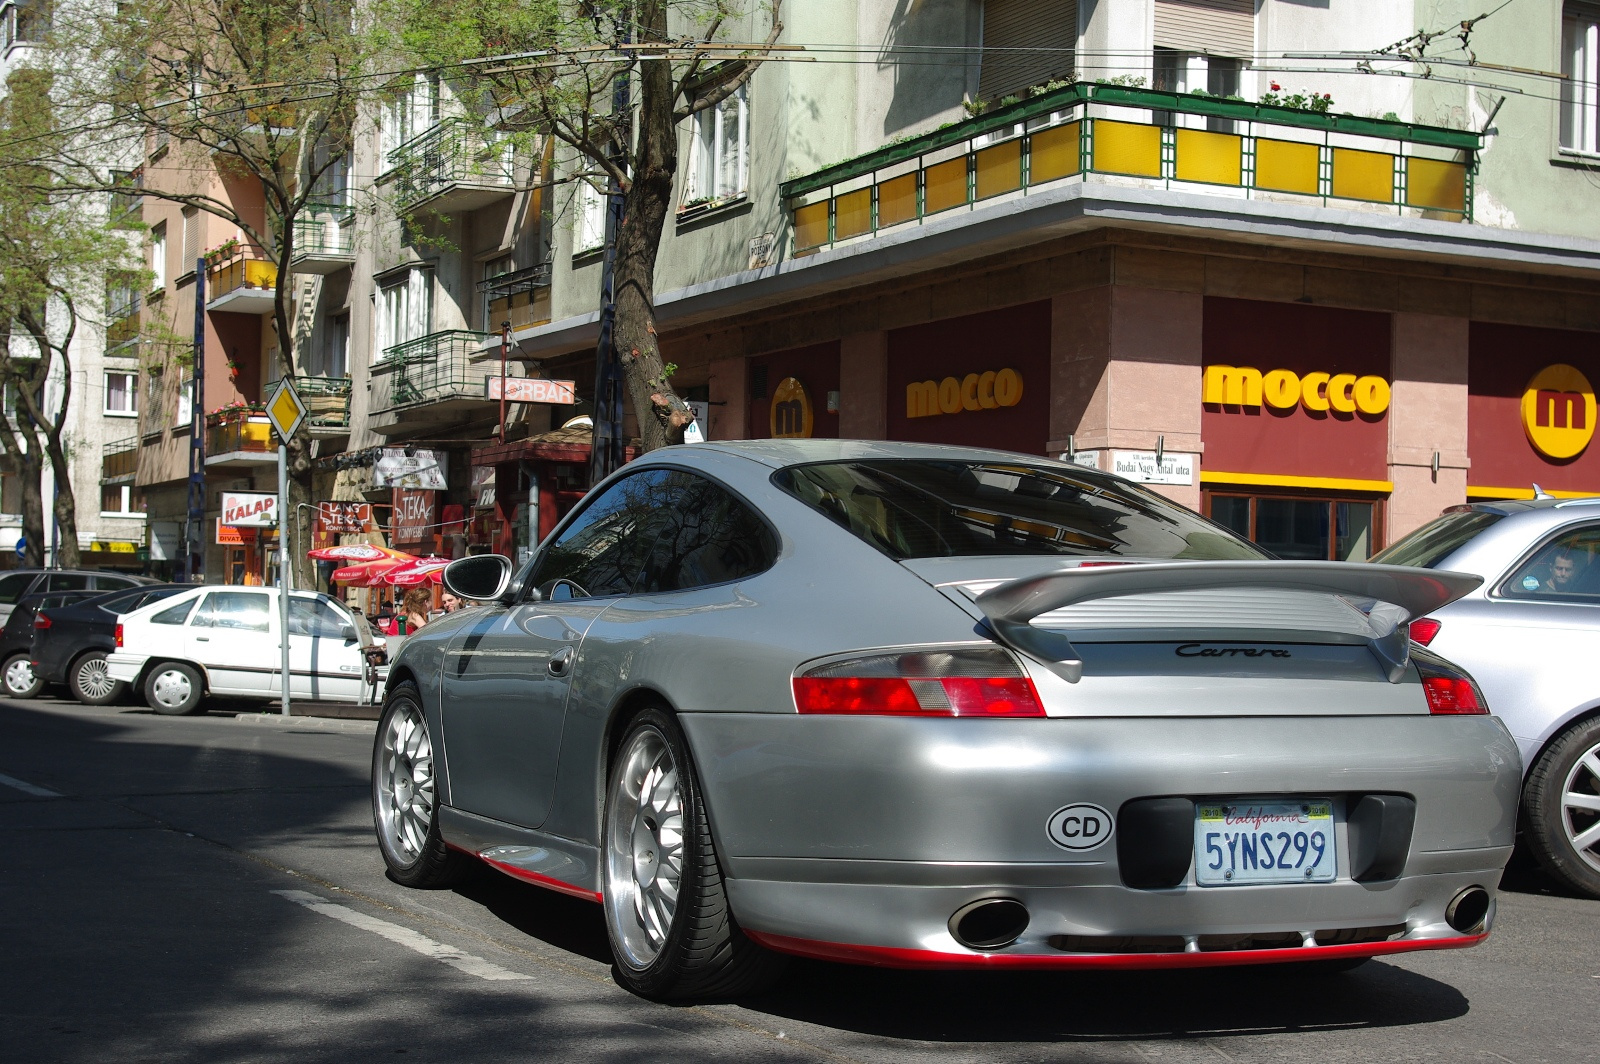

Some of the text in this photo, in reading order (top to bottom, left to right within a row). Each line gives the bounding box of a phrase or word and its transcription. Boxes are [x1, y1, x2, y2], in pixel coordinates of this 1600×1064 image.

[906, 368, 1023, 418] mocco
[1202, 364, 1391, 414] mocco
[1117, 461, 1136, 473] Budai
[1138, 461, 1154, 475] Nagy
[1175, 465, 1190, 475] utca
[225, 498, 274, 523] KALAP
[1175, 643, 1291, 658] Carrera
[1204, 809, 1219, 817] 2010
[1226, 806, 1309, 830] California
[1062, 816, 1100, 838] CD
[1206, 831, 1326, 870] 5YNS299
